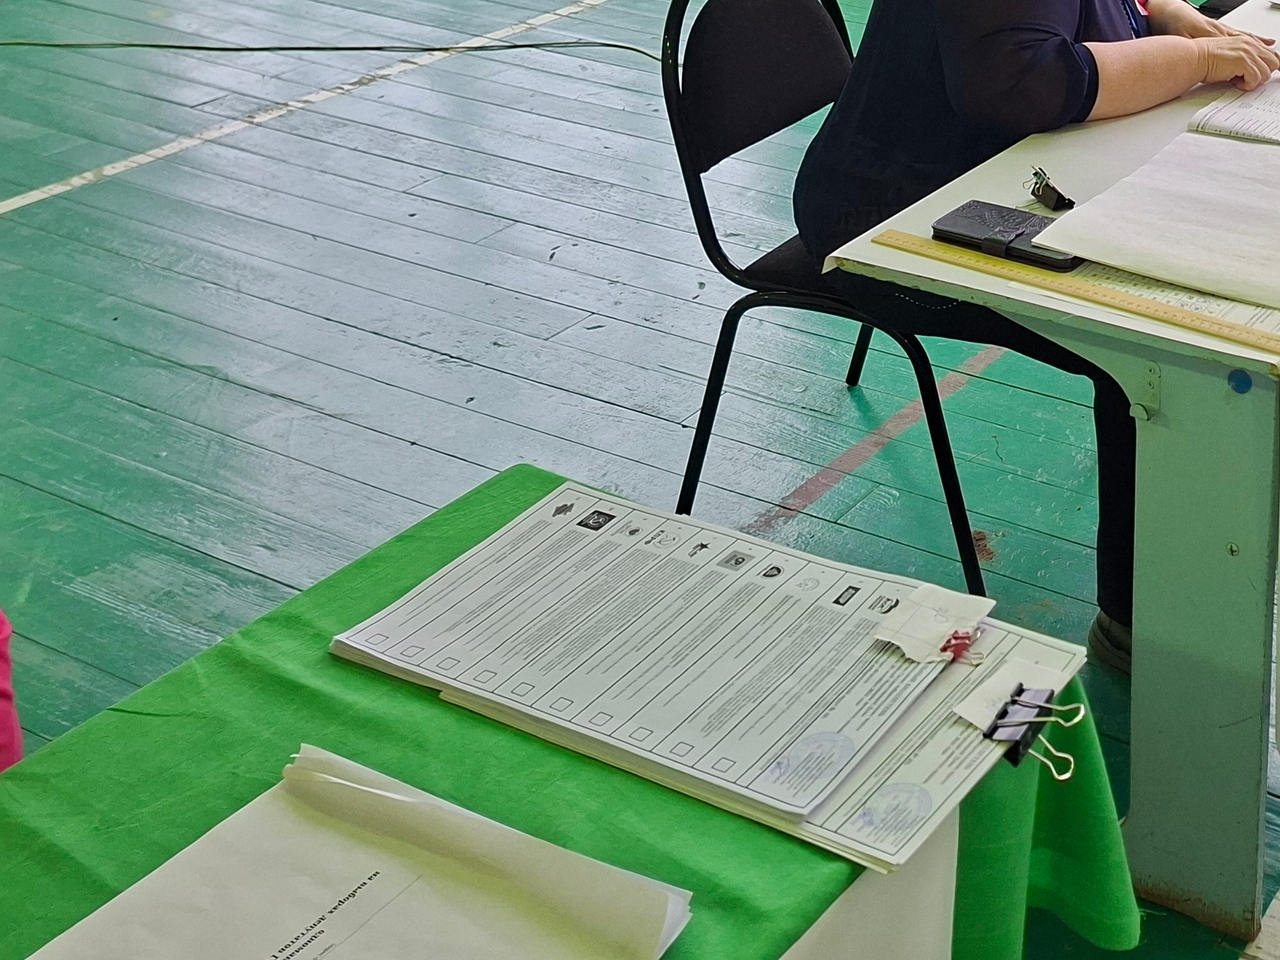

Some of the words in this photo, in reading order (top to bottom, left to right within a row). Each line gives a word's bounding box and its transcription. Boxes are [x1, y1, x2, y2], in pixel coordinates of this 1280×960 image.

[367, 870, 380, 881] на
[327, 881, 368, 915] выборах
[277, 915, 327, 954] депутатов
